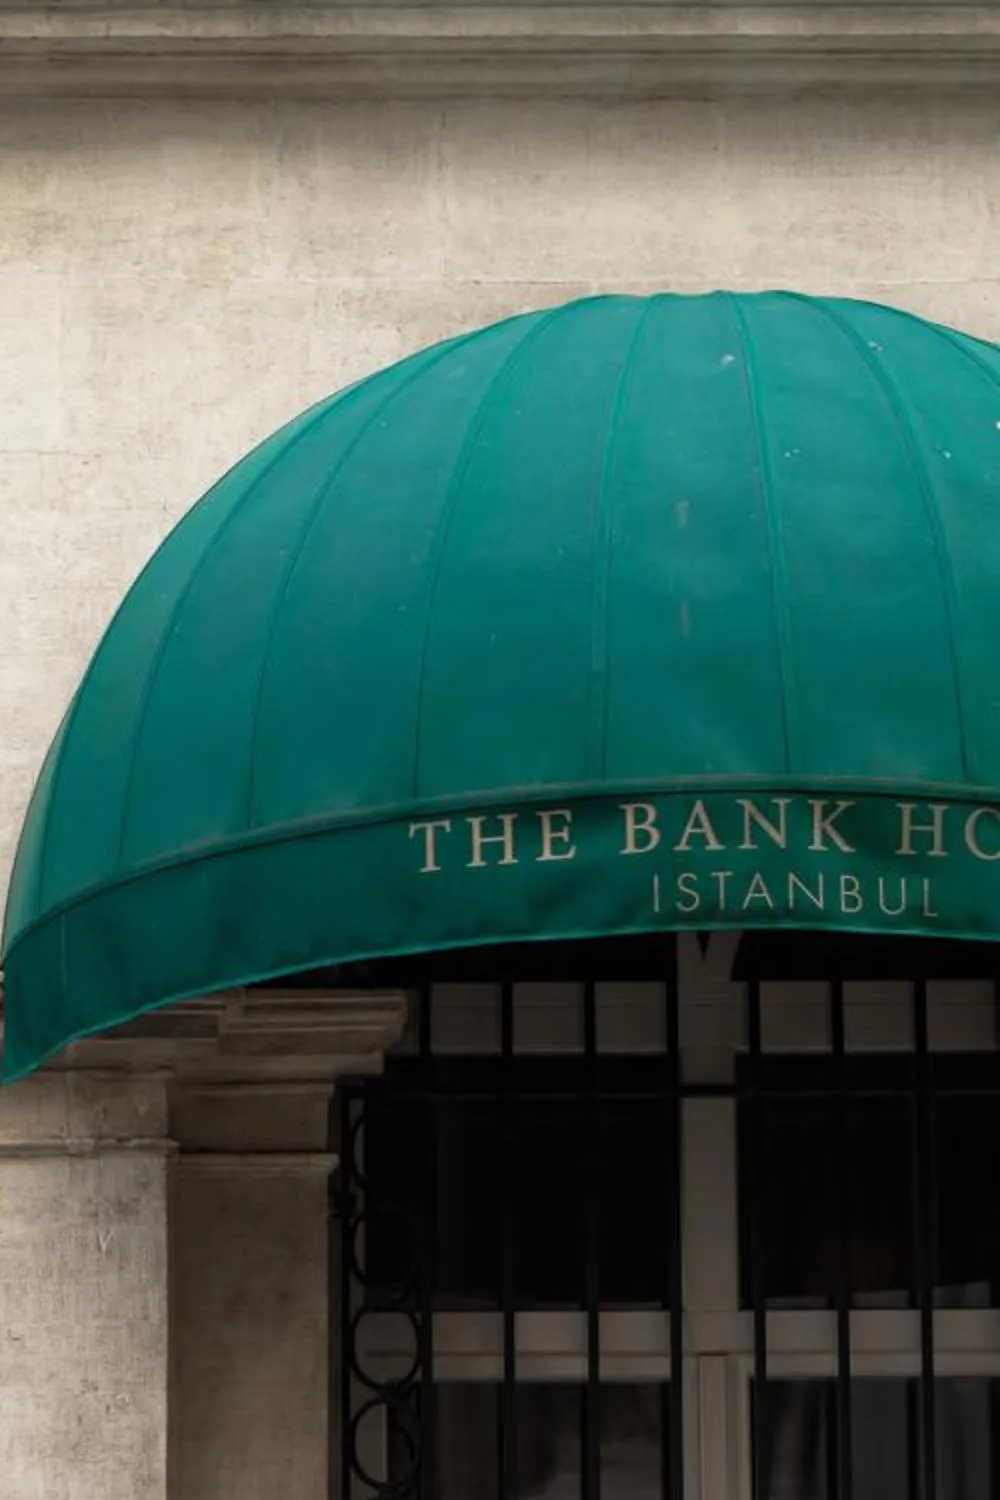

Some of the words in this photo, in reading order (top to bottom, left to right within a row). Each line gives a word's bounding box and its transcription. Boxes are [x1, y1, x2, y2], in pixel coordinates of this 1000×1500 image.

[409, 808, 577, 873] THE
[618, 799, 856, 855] BANK
[653, 871, 938, 917] ISTANBUL
